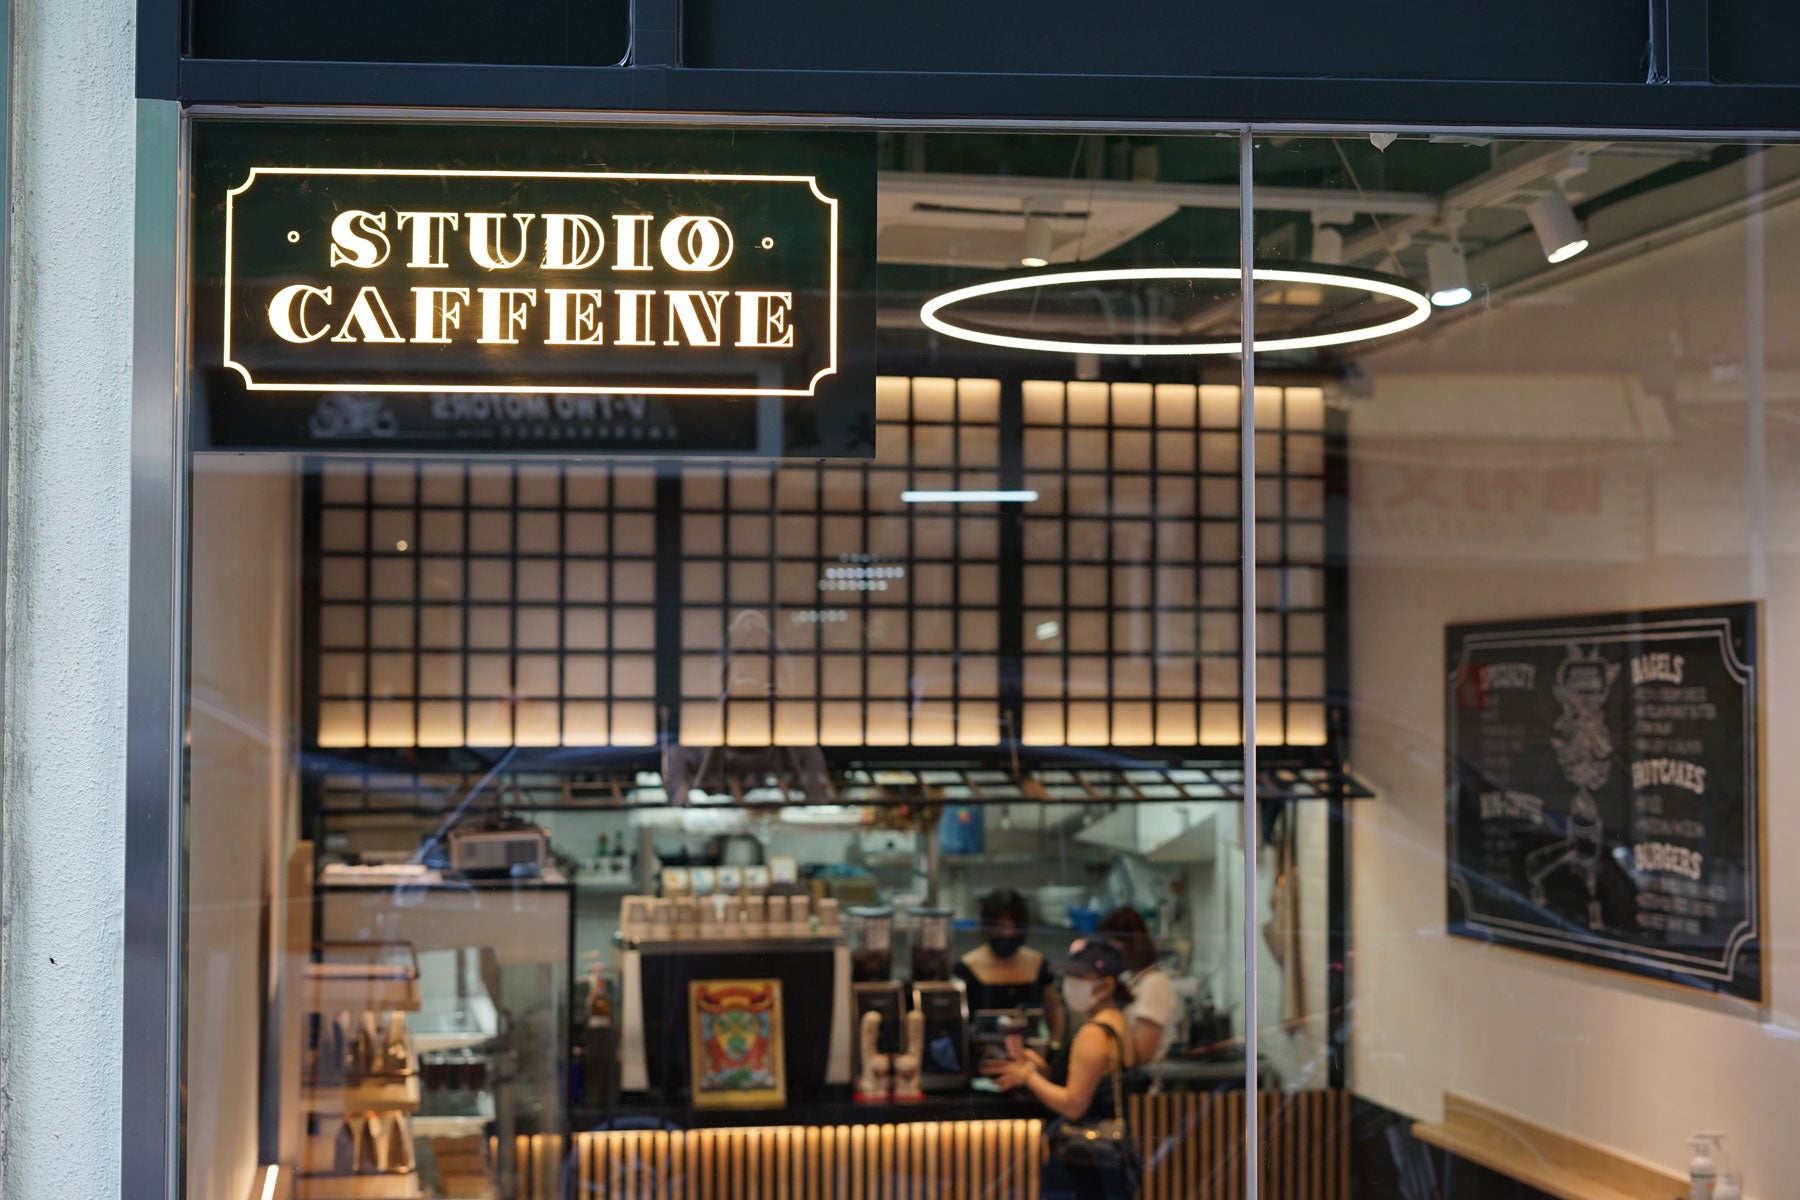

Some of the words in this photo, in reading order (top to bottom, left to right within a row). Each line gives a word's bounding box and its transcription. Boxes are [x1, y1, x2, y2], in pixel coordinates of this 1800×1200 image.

[331, 210, 733, 271] STUDIO
[268, 285, 793, 347] CAFFEINE
[1631, 654, 1685, 685] BAGELS
[1632, 842, 1702, 880] BURGERS
